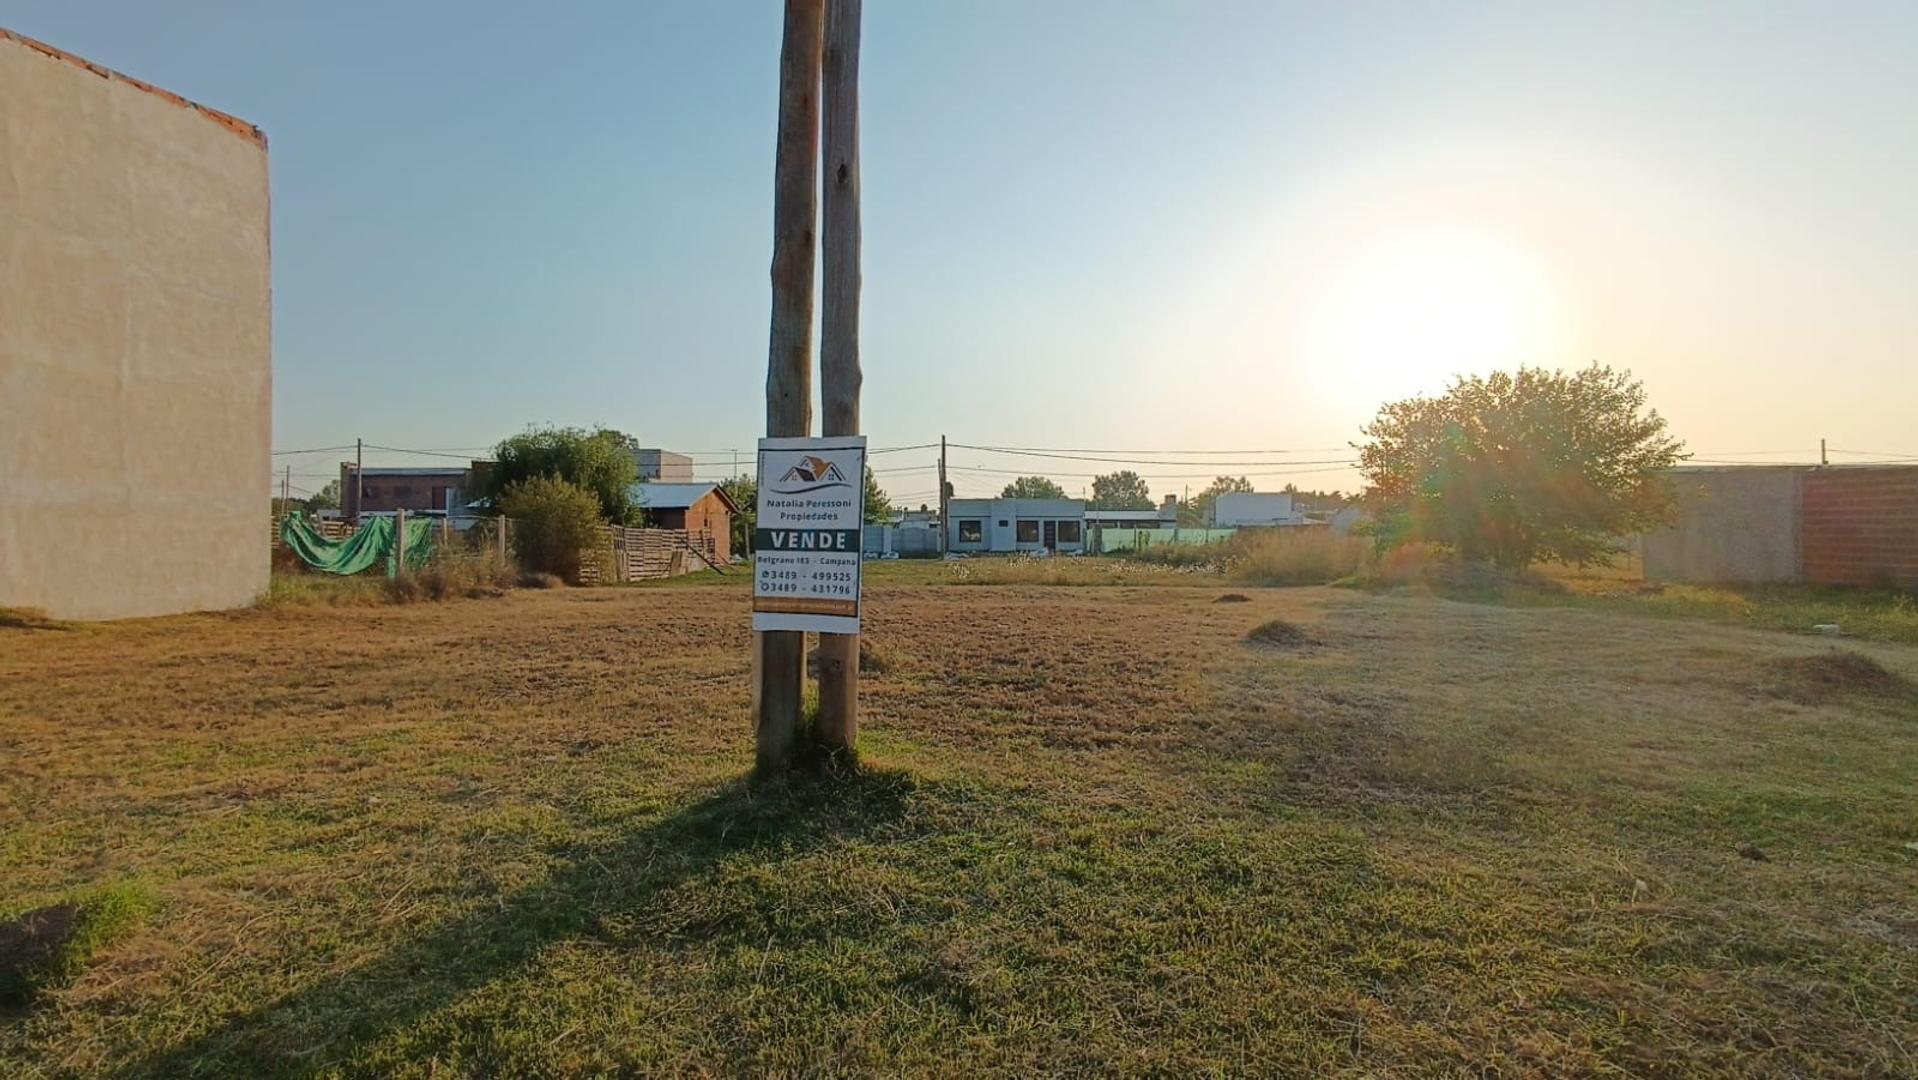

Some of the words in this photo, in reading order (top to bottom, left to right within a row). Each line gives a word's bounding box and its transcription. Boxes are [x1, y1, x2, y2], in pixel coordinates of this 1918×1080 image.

[767, 499, 804, 508] Natalia
[806, 500, 851, 508] Peressoni
[770, 531, 846, 549] VENDE
